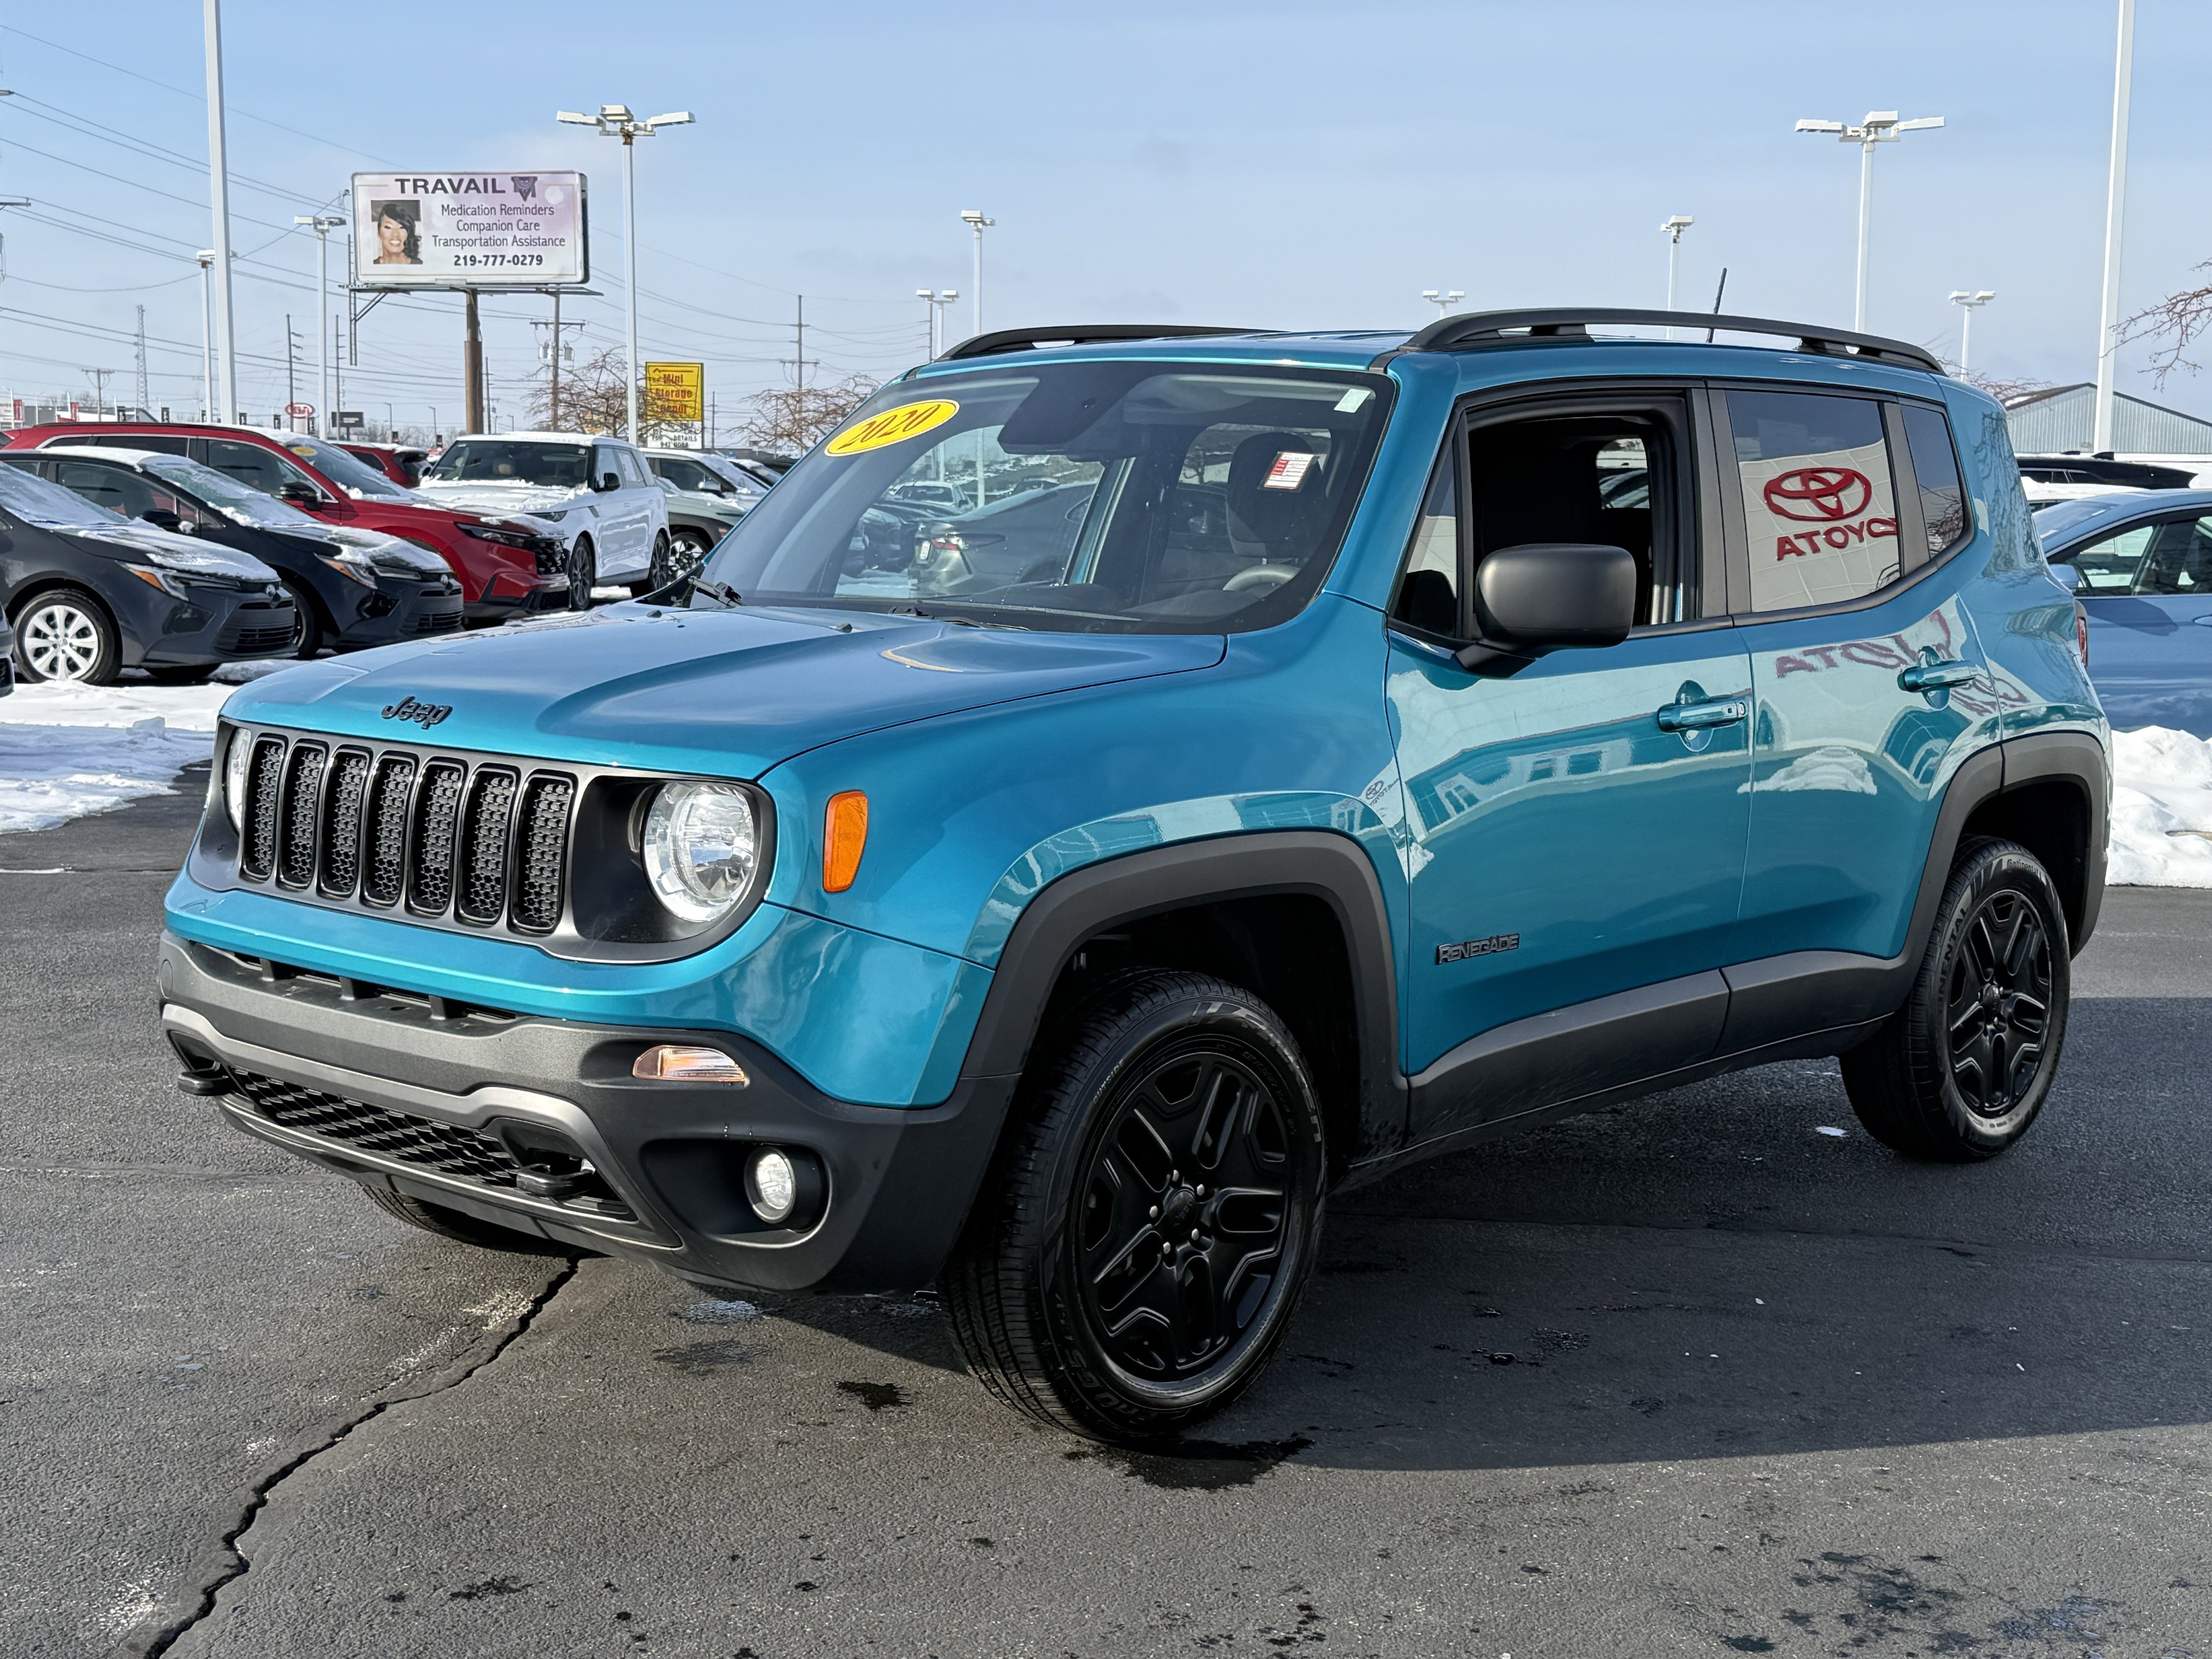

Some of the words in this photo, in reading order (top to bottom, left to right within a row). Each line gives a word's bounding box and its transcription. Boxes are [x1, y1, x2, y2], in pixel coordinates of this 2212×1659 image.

[395, 178, 506, 194] TRAVAIL
[441, 204, 496, 216] Medication
[500, 204, 555, 216] Reminders
[457, 220, 513, 234] Companion
[517, 219, 540, 231] Care
[432, 235, 508, 249] Transportation
[512, 234, 565, 247] Assistance
[454, 254, 543, 266] 219-777-0279
[663, 374, 683, 384] Mini
[837, 404, 941, 450] 2020
[381, 696, 453, 730] Jeep
[1435, 933, 1520, 965] RENEGADE
[1092, 1058, 1125, 1104] OUTSIDE
